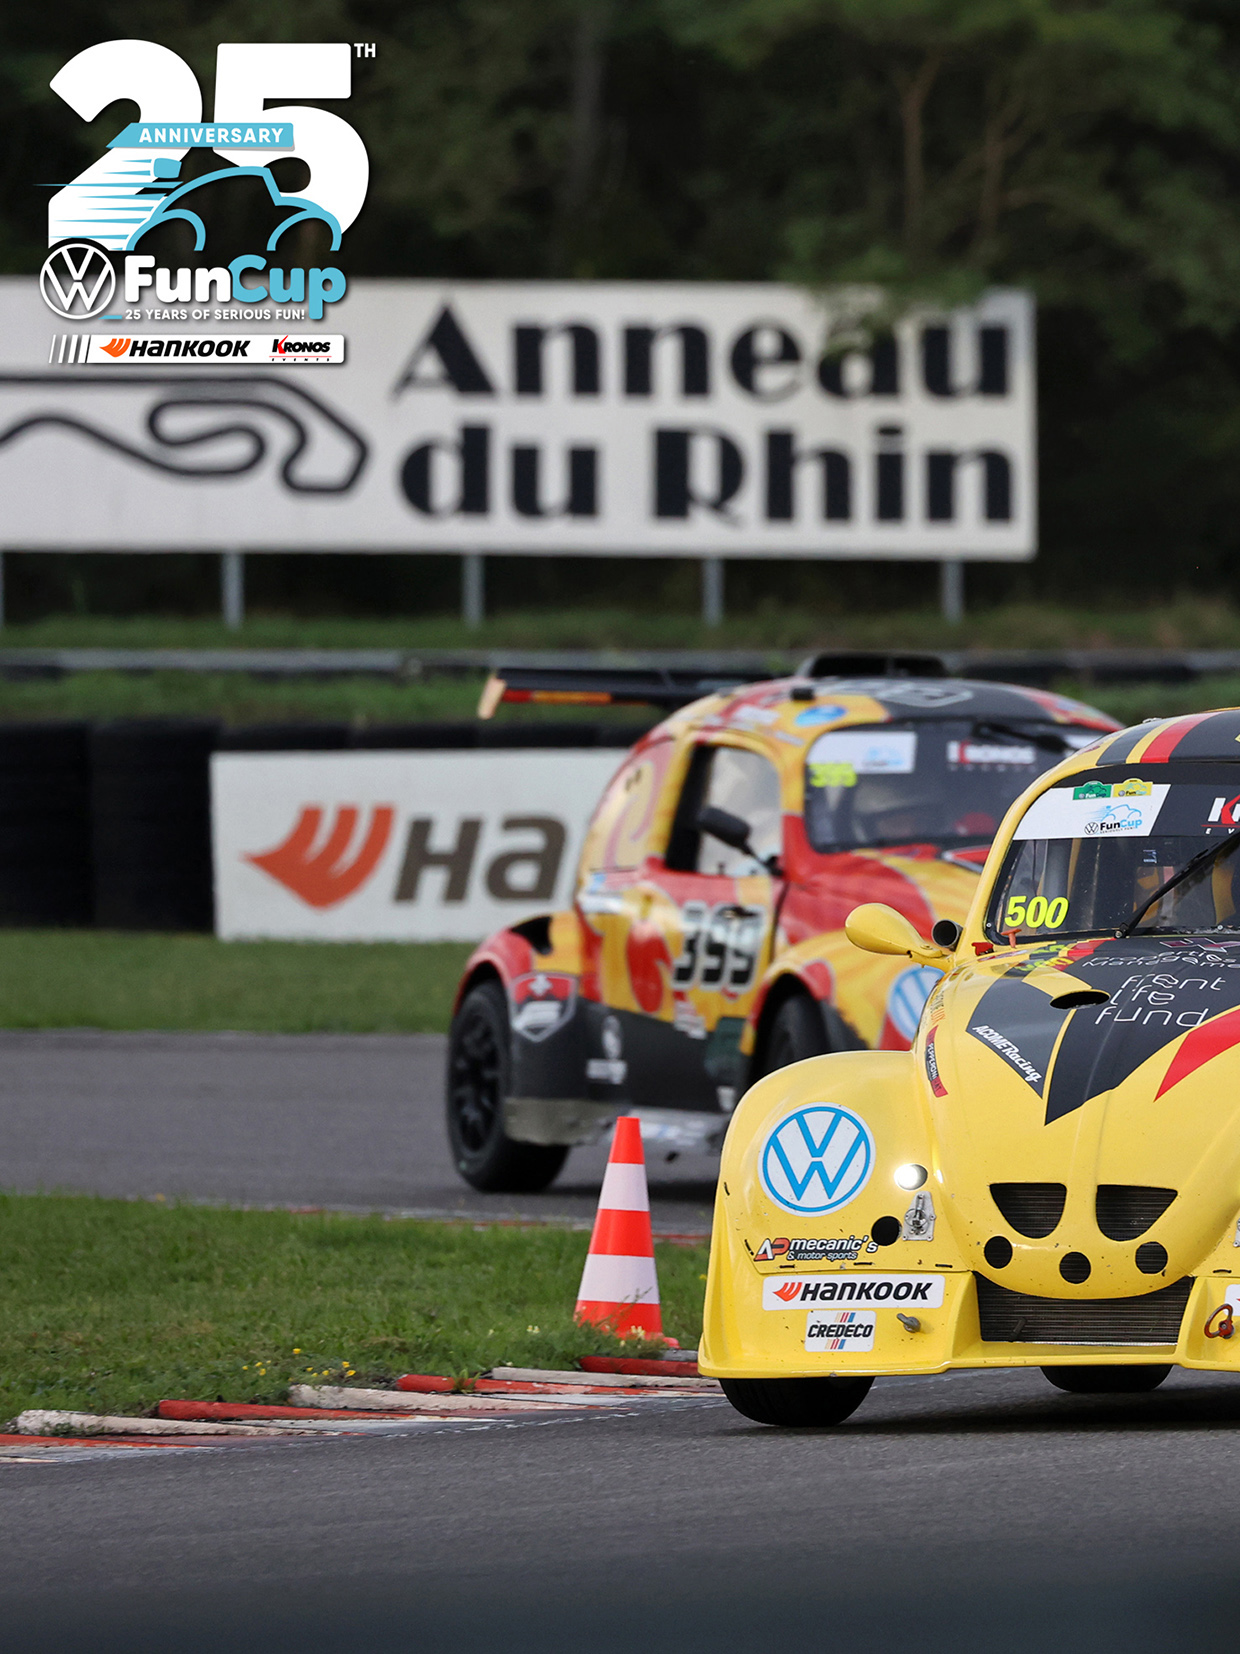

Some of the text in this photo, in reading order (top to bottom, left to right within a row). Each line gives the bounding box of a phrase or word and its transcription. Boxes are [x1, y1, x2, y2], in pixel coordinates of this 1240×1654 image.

[388, 300, 1012, 402] Anneau
[398, 422, 1016, 526] du Rhin
[1100, 819, 1142, 832] FunCup
[1004, 895, 1069, 929] 500
[1110, 985, 1176, 1005] lfe
[1095, 1006, 1210, 1027] fund
[754, 1238, 790, 1261] AP
[787, 1251, 857, 1262] & motor sports
[807, 1322, 874, 1338] CREDECO
